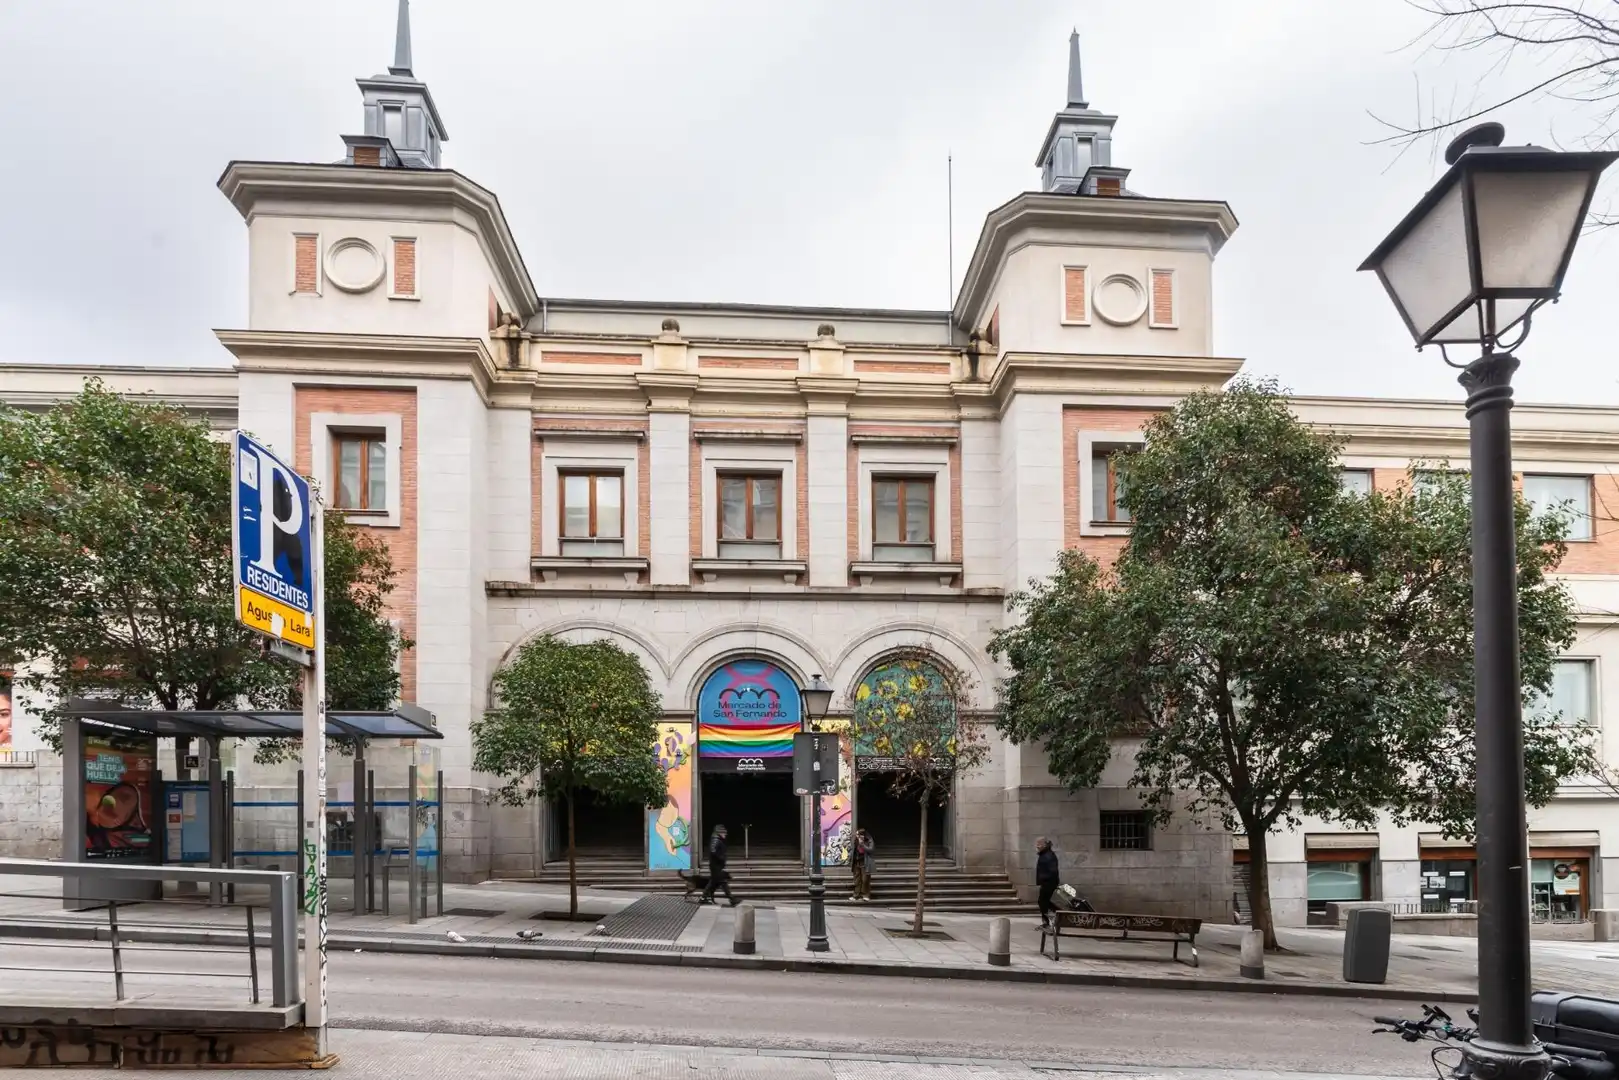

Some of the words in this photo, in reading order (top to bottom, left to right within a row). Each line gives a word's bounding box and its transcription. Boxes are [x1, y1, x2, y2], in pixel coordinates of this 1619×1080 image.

[248, 443, 303, 578] P
[247, 566, 309, 609] RESIDENTES
[247, 601, 287, 628] Agusn
[290, 618, 311, 637] Lara
[718, 701, 766, 709] Mercado
[768, 701, 782, 709] de
[713, 709, 734, 718] San
[736, 709, 788, 718] Fernando
[86, 761, 105, 770] QUE
[86, 770, 121, 781] HUELLA
